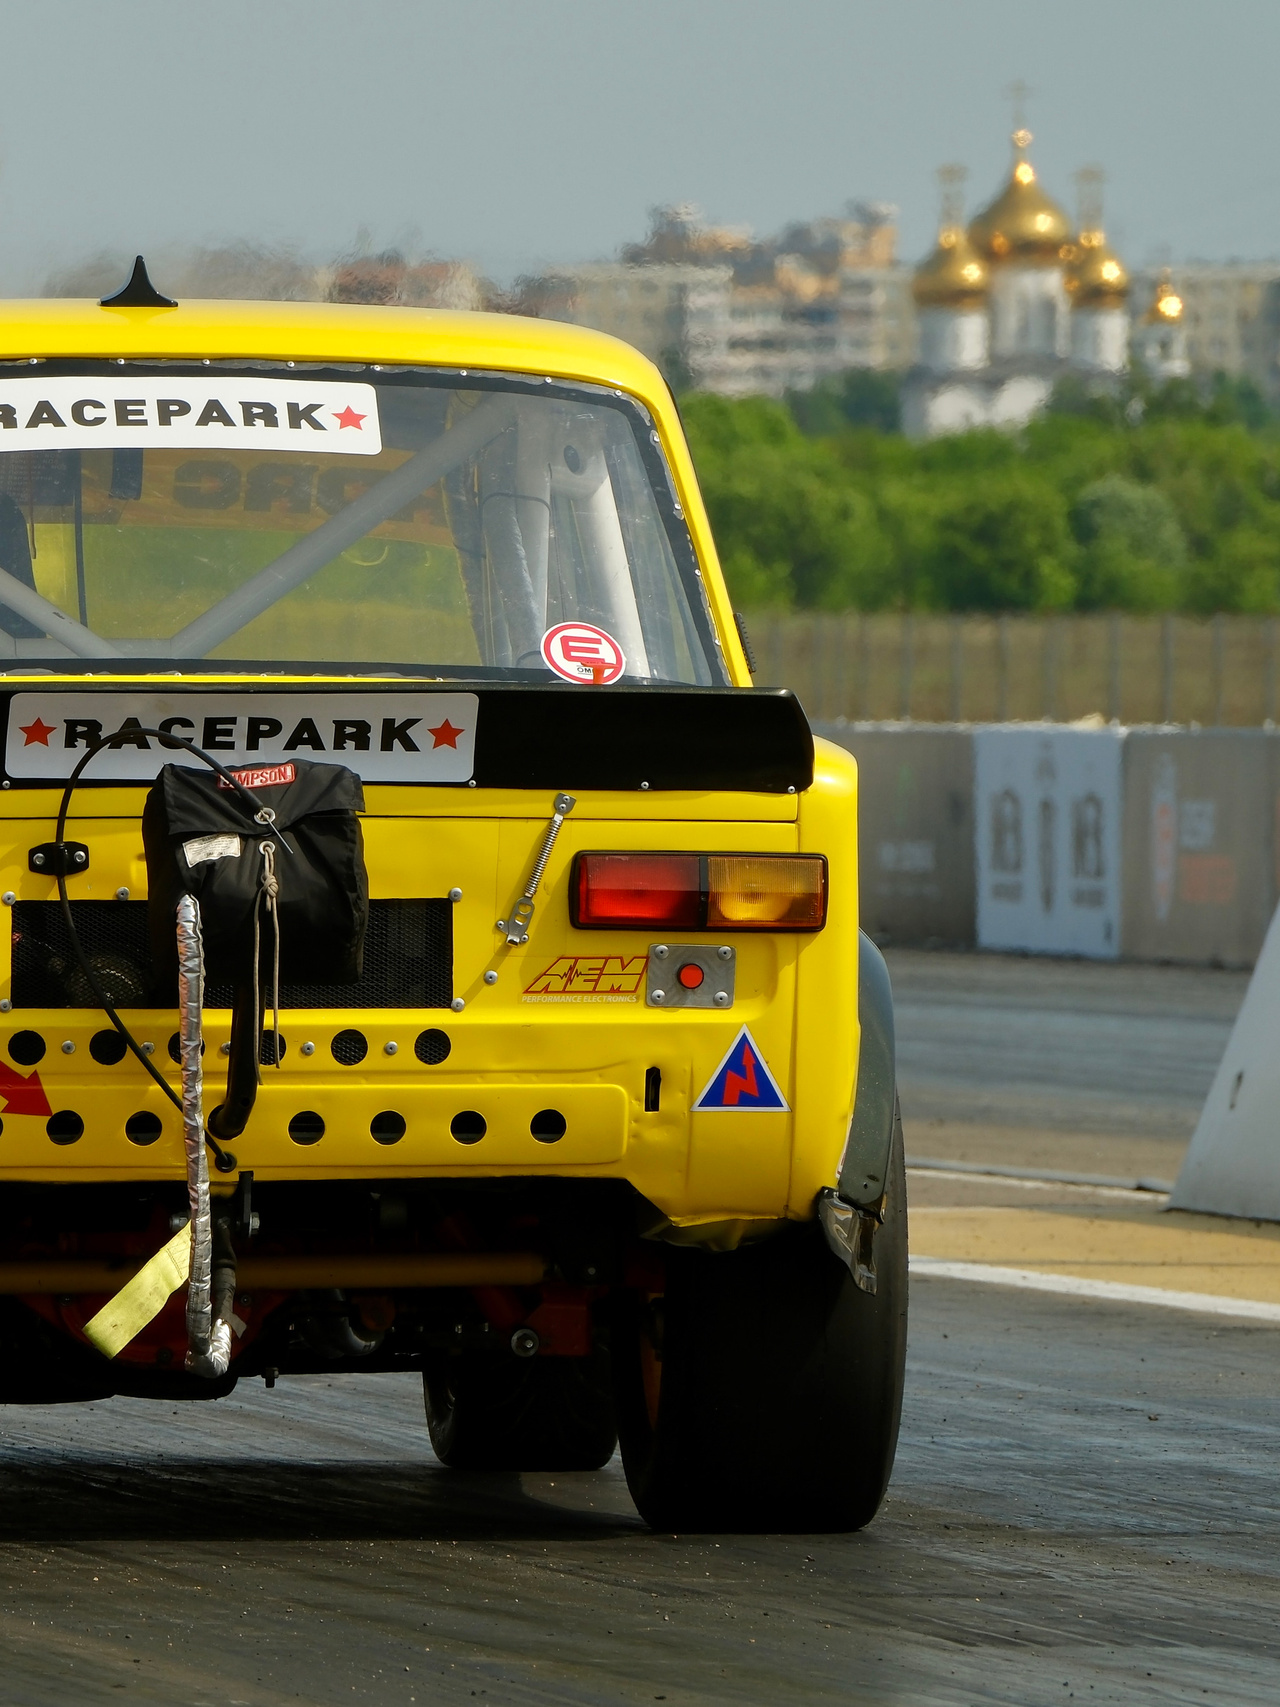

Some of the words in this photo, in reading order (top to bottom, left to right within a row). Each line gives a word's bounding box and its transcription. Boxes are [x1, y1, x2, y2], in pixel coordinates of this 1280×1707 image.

[560, 635, 604, 663] E
[62, 717, 424, 752] RACEPARK
[222, 765, 289, 787] IMPSON
[523, 956, 649, 994] AEM
[522, 995, 582, 1003] PERFORMANCE
[583, 994, 637, 1003] ELECTRONICS
